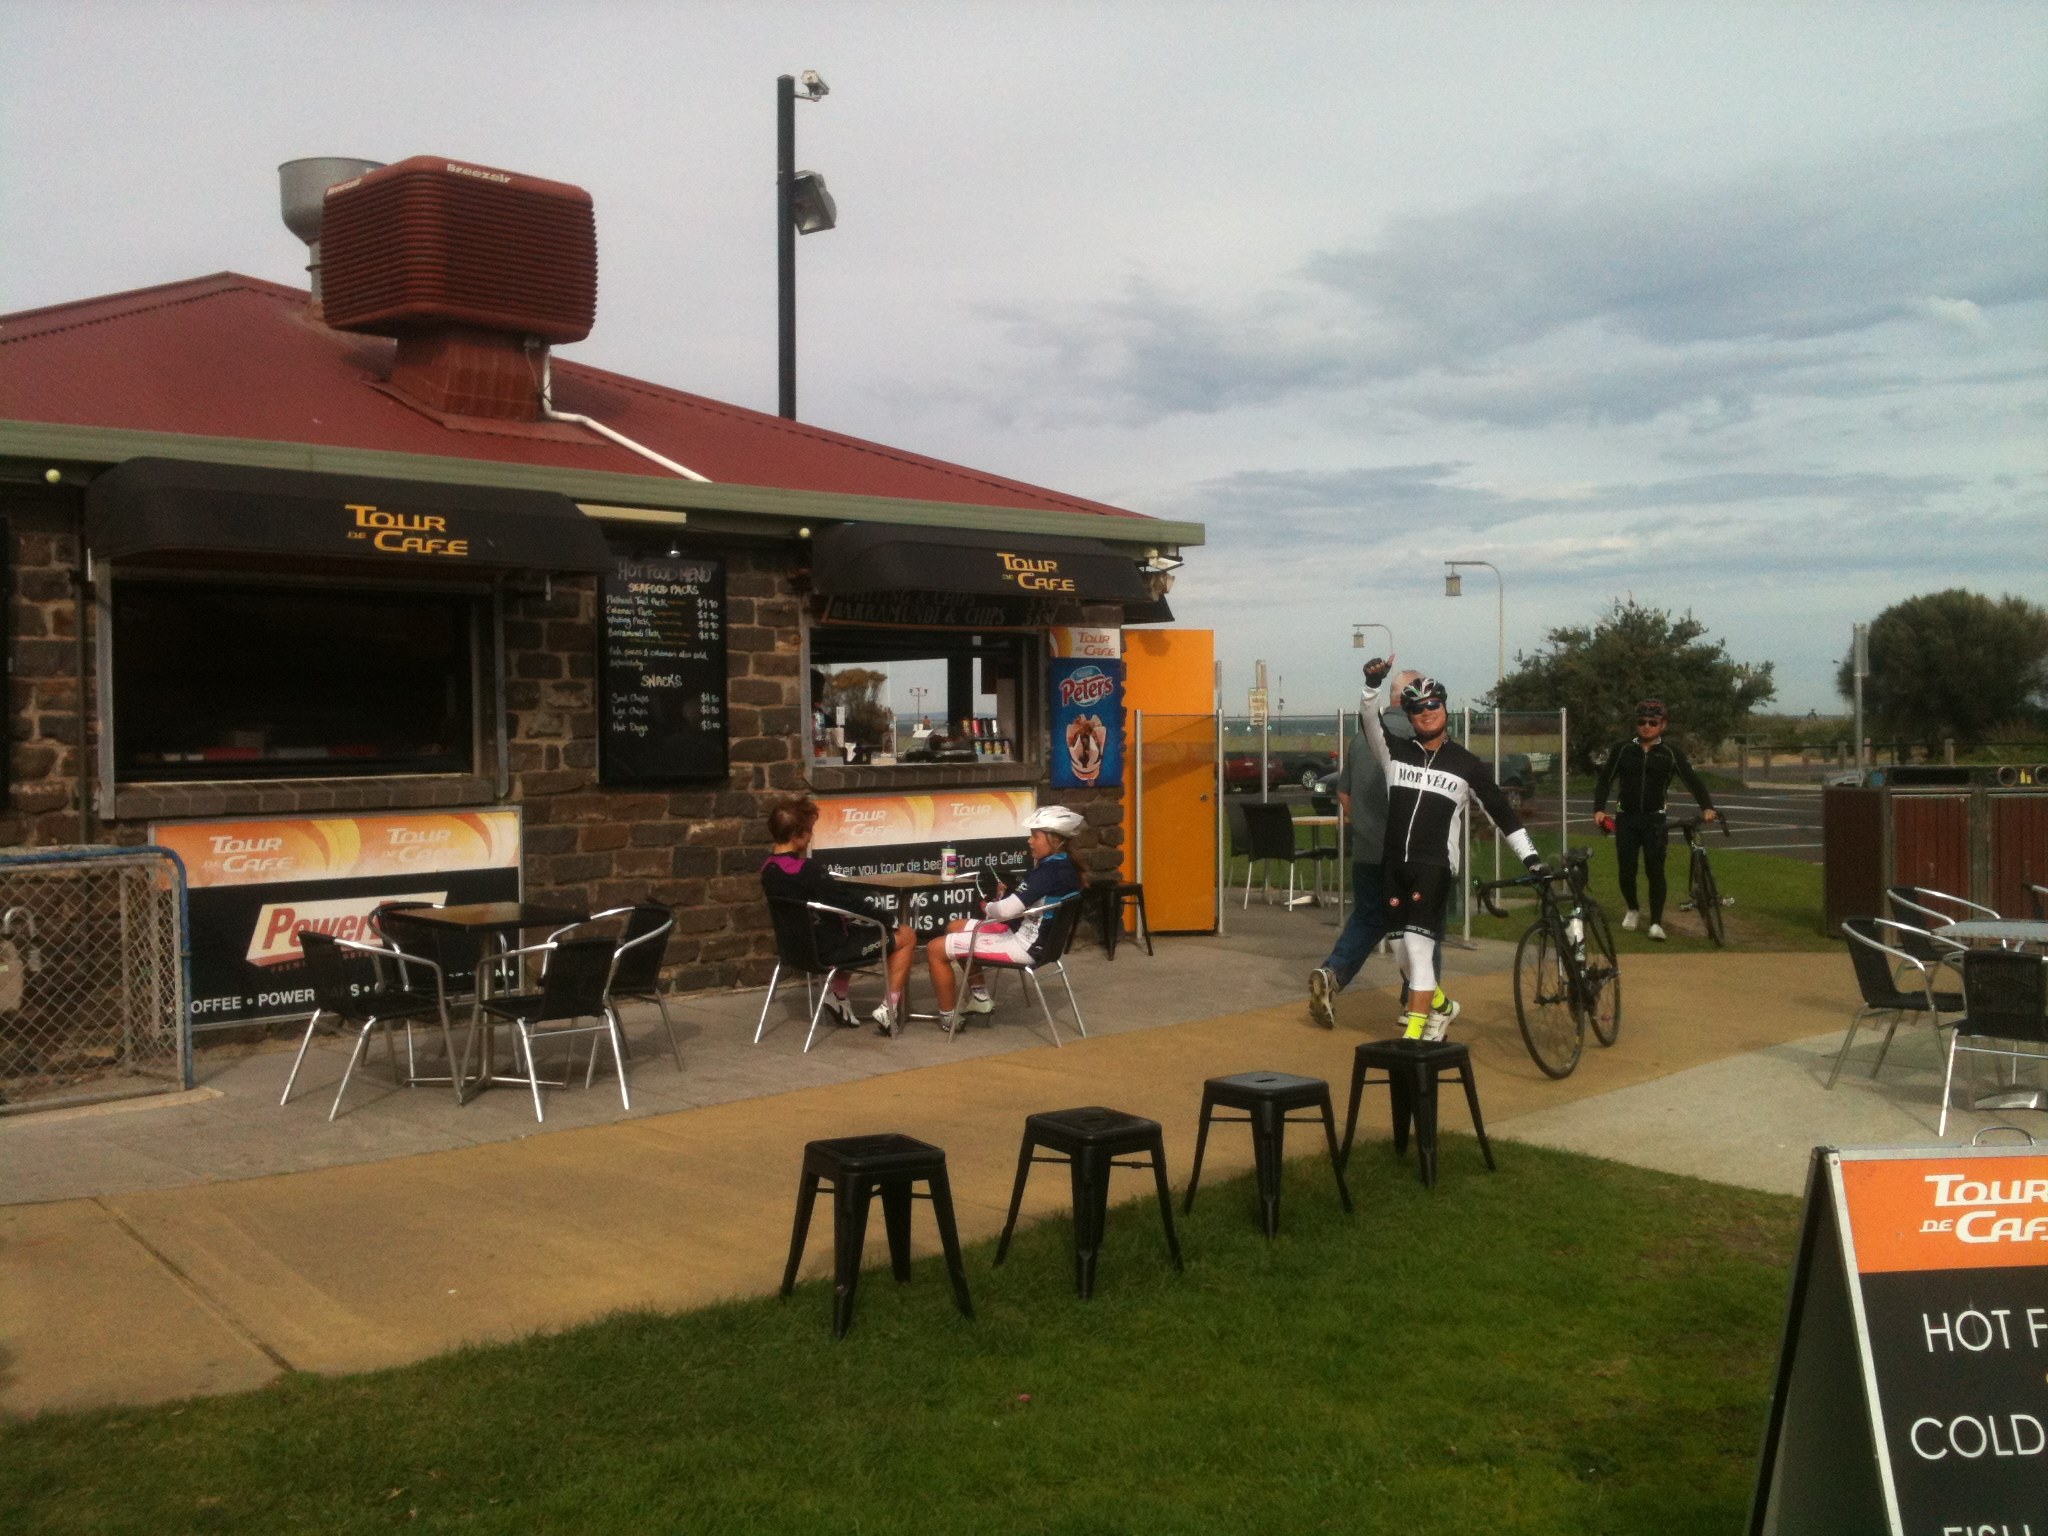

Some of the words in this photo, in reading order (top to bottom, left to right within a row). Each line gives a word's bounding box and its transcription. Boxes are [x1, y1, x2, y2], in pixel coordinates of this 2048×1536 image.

[345, 504, 446, 532] TOUR
[374, 530, 468, 555] CAFE
[997, 553, 1057, 573] TOUR
[628, 583, 668, 594] SEAFOOD
[670, 584, 699, 595] PACKS
[1018, 572, 1075, 591] CAFE
[641, 674, 682, 688] SNACKS
[1059, 675, 1114, 705] Peters
[842, 808, 886, 823] TOUR
[209, 836, 283, 854] TOUR
[387, 828, 451, 845] TOUR
[223, 855, 295, 873] CAFE
[880, 862, 905, 874] tour
[906, 859, 921, 872] de
[957, 855, 981, 868] Tour
[984, 852, 998, 866] de
[944, 888, 975, 905] HOT
[188, 996, 242, 1013] OFFEE
[258, 988, 316, 1008] POWER
[1924, 1174, 2048, 1207] TOUR
[1919, 1219, 1953, 1233] DE
[1956, 1210, 2048, 1244] CAF
[1922, 1309, 2011, 1352] HOT
[1910, 1414, 2046, 1461] COLD
